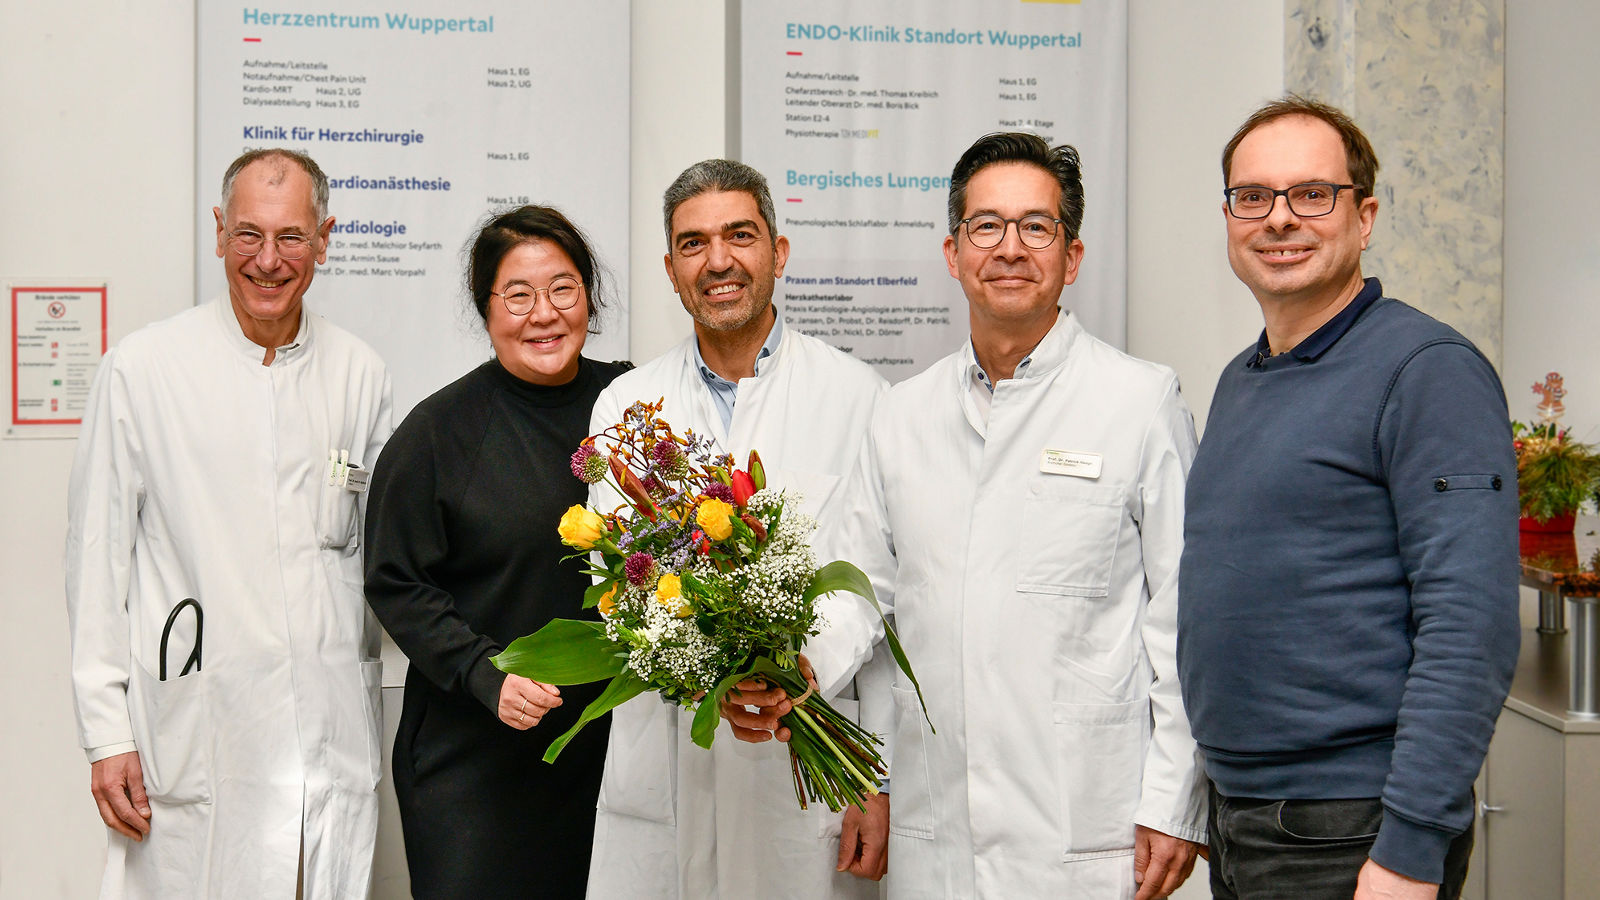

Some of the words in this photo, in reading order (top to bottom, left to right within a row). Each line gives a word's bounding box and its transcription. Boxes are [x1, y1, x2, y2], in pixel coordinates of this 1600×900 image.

[243, 8, 380, 29] Herzzentrum
[385, 12, 494, 34] Wuppertal
[786, 23, 900, 42] ENDO-Klinik
[904, 28, 983, 45] Standort
[988, 30, 1082, 49] Wuppertal
[243, 60, 328, 70] Aufnahme/Leitstelle
[487, 67, 508, 76] Haus
[518, 67, 530, 76] EG
[243, 72, 328, 83] Notaufnahme/Chest
[330, 75, 347, 83] Pain
[348, 76, 366, 84] Unit
[785, 72, 860, 82] Aufnahme/Leitstelle
[999, 78, 1017, 86] Haus
[1026, 78, 1037, 86] EG
[487, 80, 508, 88] Haus
[518, 80, 531, 88] UG
[243, 85, 293, 94] Kardio-MRT
[316, 88, 337, 96] Haus
[347, 88, 361, 96] UG
[785, 87, 844, 96] Chefarztbereich
[847, 89, 859, 97] Dr.
[860, 90, 878, 98] med.
[880, 90, 907, 98] Thomas
[243, 97, 311, 109] Dialyseabteilung
[316, 100, 337, 108] Haus
[347, 100, 360, 108] EG
[785, 99, 819, 107] Leitender
[821, 100, 852, 108] Oberarzt
[904, 102, 919, 110] Bick
[785, 114, 811, 122] Station
[1034, 120, 1054, 128] Etage
[243, 126, 287, 140] Klinik
[291, 127, 315, 141] für
[318, 129, 425, 146] Herzchirurgie
[785, 129, 839, 138] Physiotherapie
[517, 152, 530, 160] EG
[327, 175, 452, 191] ardioanästhesie
[786, 170, 883, 190] Bergisches
[887, 173, 952, 192] Lungen
[487, 196, 507, 204] Haus
[517, 196, 529, 204] EG
[329, 220, 406, 237] ardiologie
[785, 218, 847, 228] Pneumologisches
[893, 220, 935, 229] Anmeldung
[335, 241, 347, 249] Dr.
[350, 242, 368, 250] med.
[372, 242, 407, 250] Melchior
[409, 242, 442, 252] Seyfarth
[350, 254, 376, 262] Armin
[377, 254, 400, 263] Sause
[349, 268, 369, 276] med.
[371, 268, 392, 276] Marc
[394, 268, 426, 277] Vorpahl
[785, 276, 817, 285] Praxen
[819, 277, 833, 285] am
[835, 276, 875, 286] Standort
[877, 276, 918, 286] Elberfeld
[785, 293, 854, 301] Herzkatheterlabor
[861, 356, 914, 366] schaftspraxis
